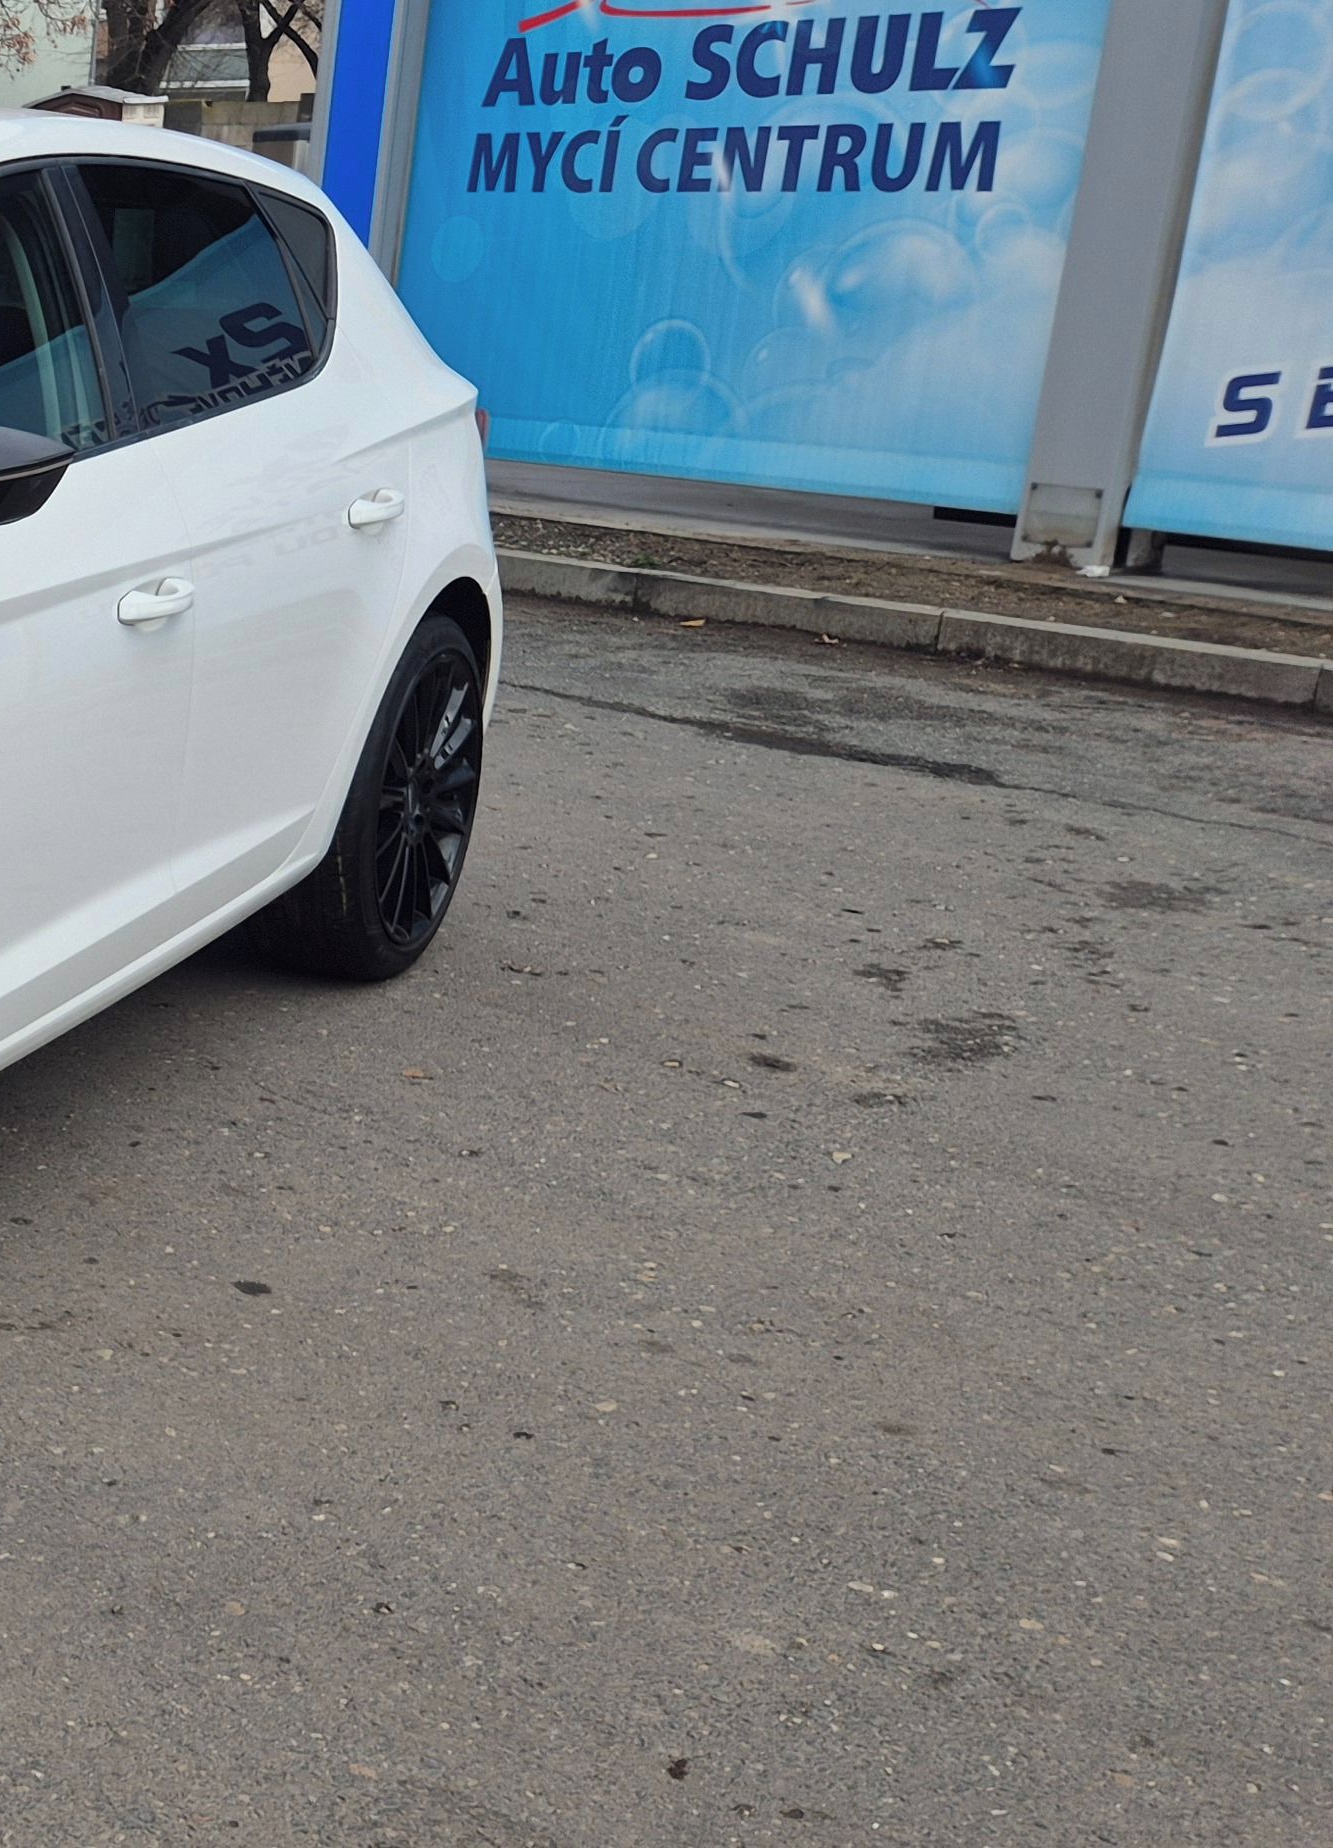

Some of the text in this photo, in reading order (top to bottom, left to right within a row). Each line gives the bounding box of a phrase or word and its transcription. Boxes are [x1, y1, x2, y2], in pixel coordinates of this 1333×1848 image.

[481, 7, 1023, 107] Auto SCHULZ
[466, 114, 1001, 193] MYCÍ CENTRUM
